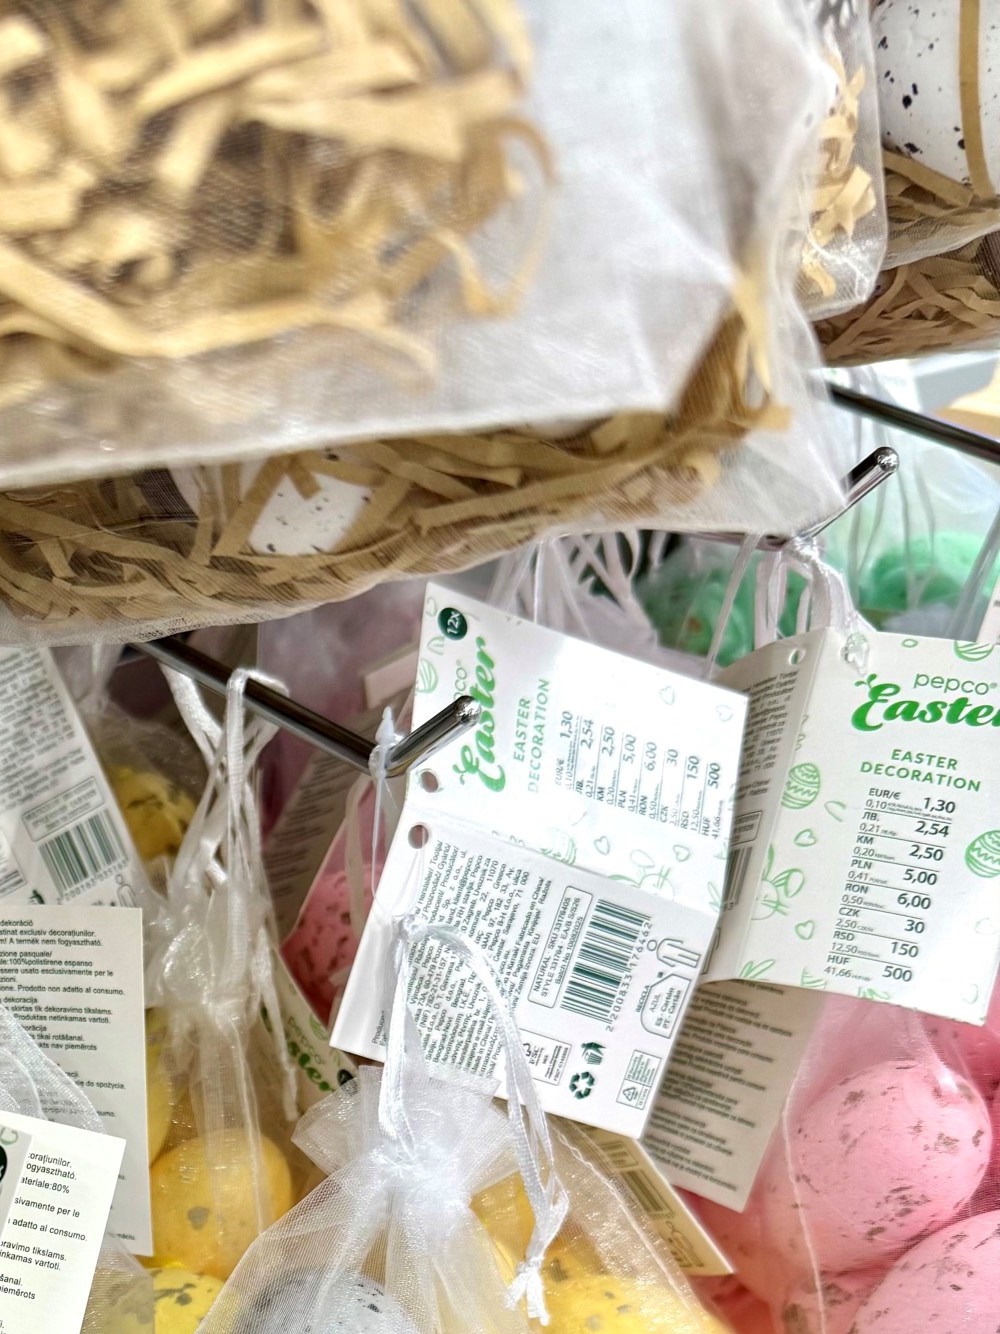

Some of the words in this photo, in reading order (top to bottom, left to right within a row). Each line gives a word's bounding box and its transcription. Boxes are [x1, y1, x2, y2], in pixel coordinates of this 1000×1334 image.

[453, 636, 505, 793] Easter
[851, 680, 1000, 731] Easte
[513, 697, 531, 762] EASTER
[528, 678, 551, 793] DECORATION
[559, 710, 573, 739] 1,30
[580, 718, 594, 749] 2,54
[601, 726, 615, 757] 2,50
[622, 734, 637, 764] 5,00
[645, 742, 657, 771] 6,00
[666, 748, 678, 767] 30
[686, 755, 700, 780] 150
[891, 748, 958, 770] EASTER
[707, 762, 721, 789] 500
[860, 761, 981, 792] DECORATION
[868, 787, 901, 800] EUR/€
[923, 797, 956, 814] 1,30
[914, 820, 949, 837] 2,54
[856, 835, 874, 845] KM
[909, 844, 944, 861] 2,50
[850, 860, 872, 870] PLN
[902, 868, 938, 885] 5,00
[844, 883, 869, 894] RON
[897, 893, 931, 910] 6,00
[839, 907, 860, 917] CZK
[904, 919, 925, 934] 30
[833, 930, 855, 941] RSD
[890, 941, 919, 958] 150
[533, 956, 549, 992] NATURAL
[548, 932, 558, 950] SKU
[827, 955, 850, 965] HUF
[882, 965, 912, 982] 500
[541, 972, 552, 997] STYLE
[56, 1206, 71, 1215] per
[72, 1209, 80, 1217] le
[12, 1218, 38, 1230] adatto
[40, 1224, 48, 1232] al
[49, 1227, 88, 1241] consumo.
[32, 1246, 67, 1261] tikslams.
[35, 1258, 61, 1271] vartoti.
